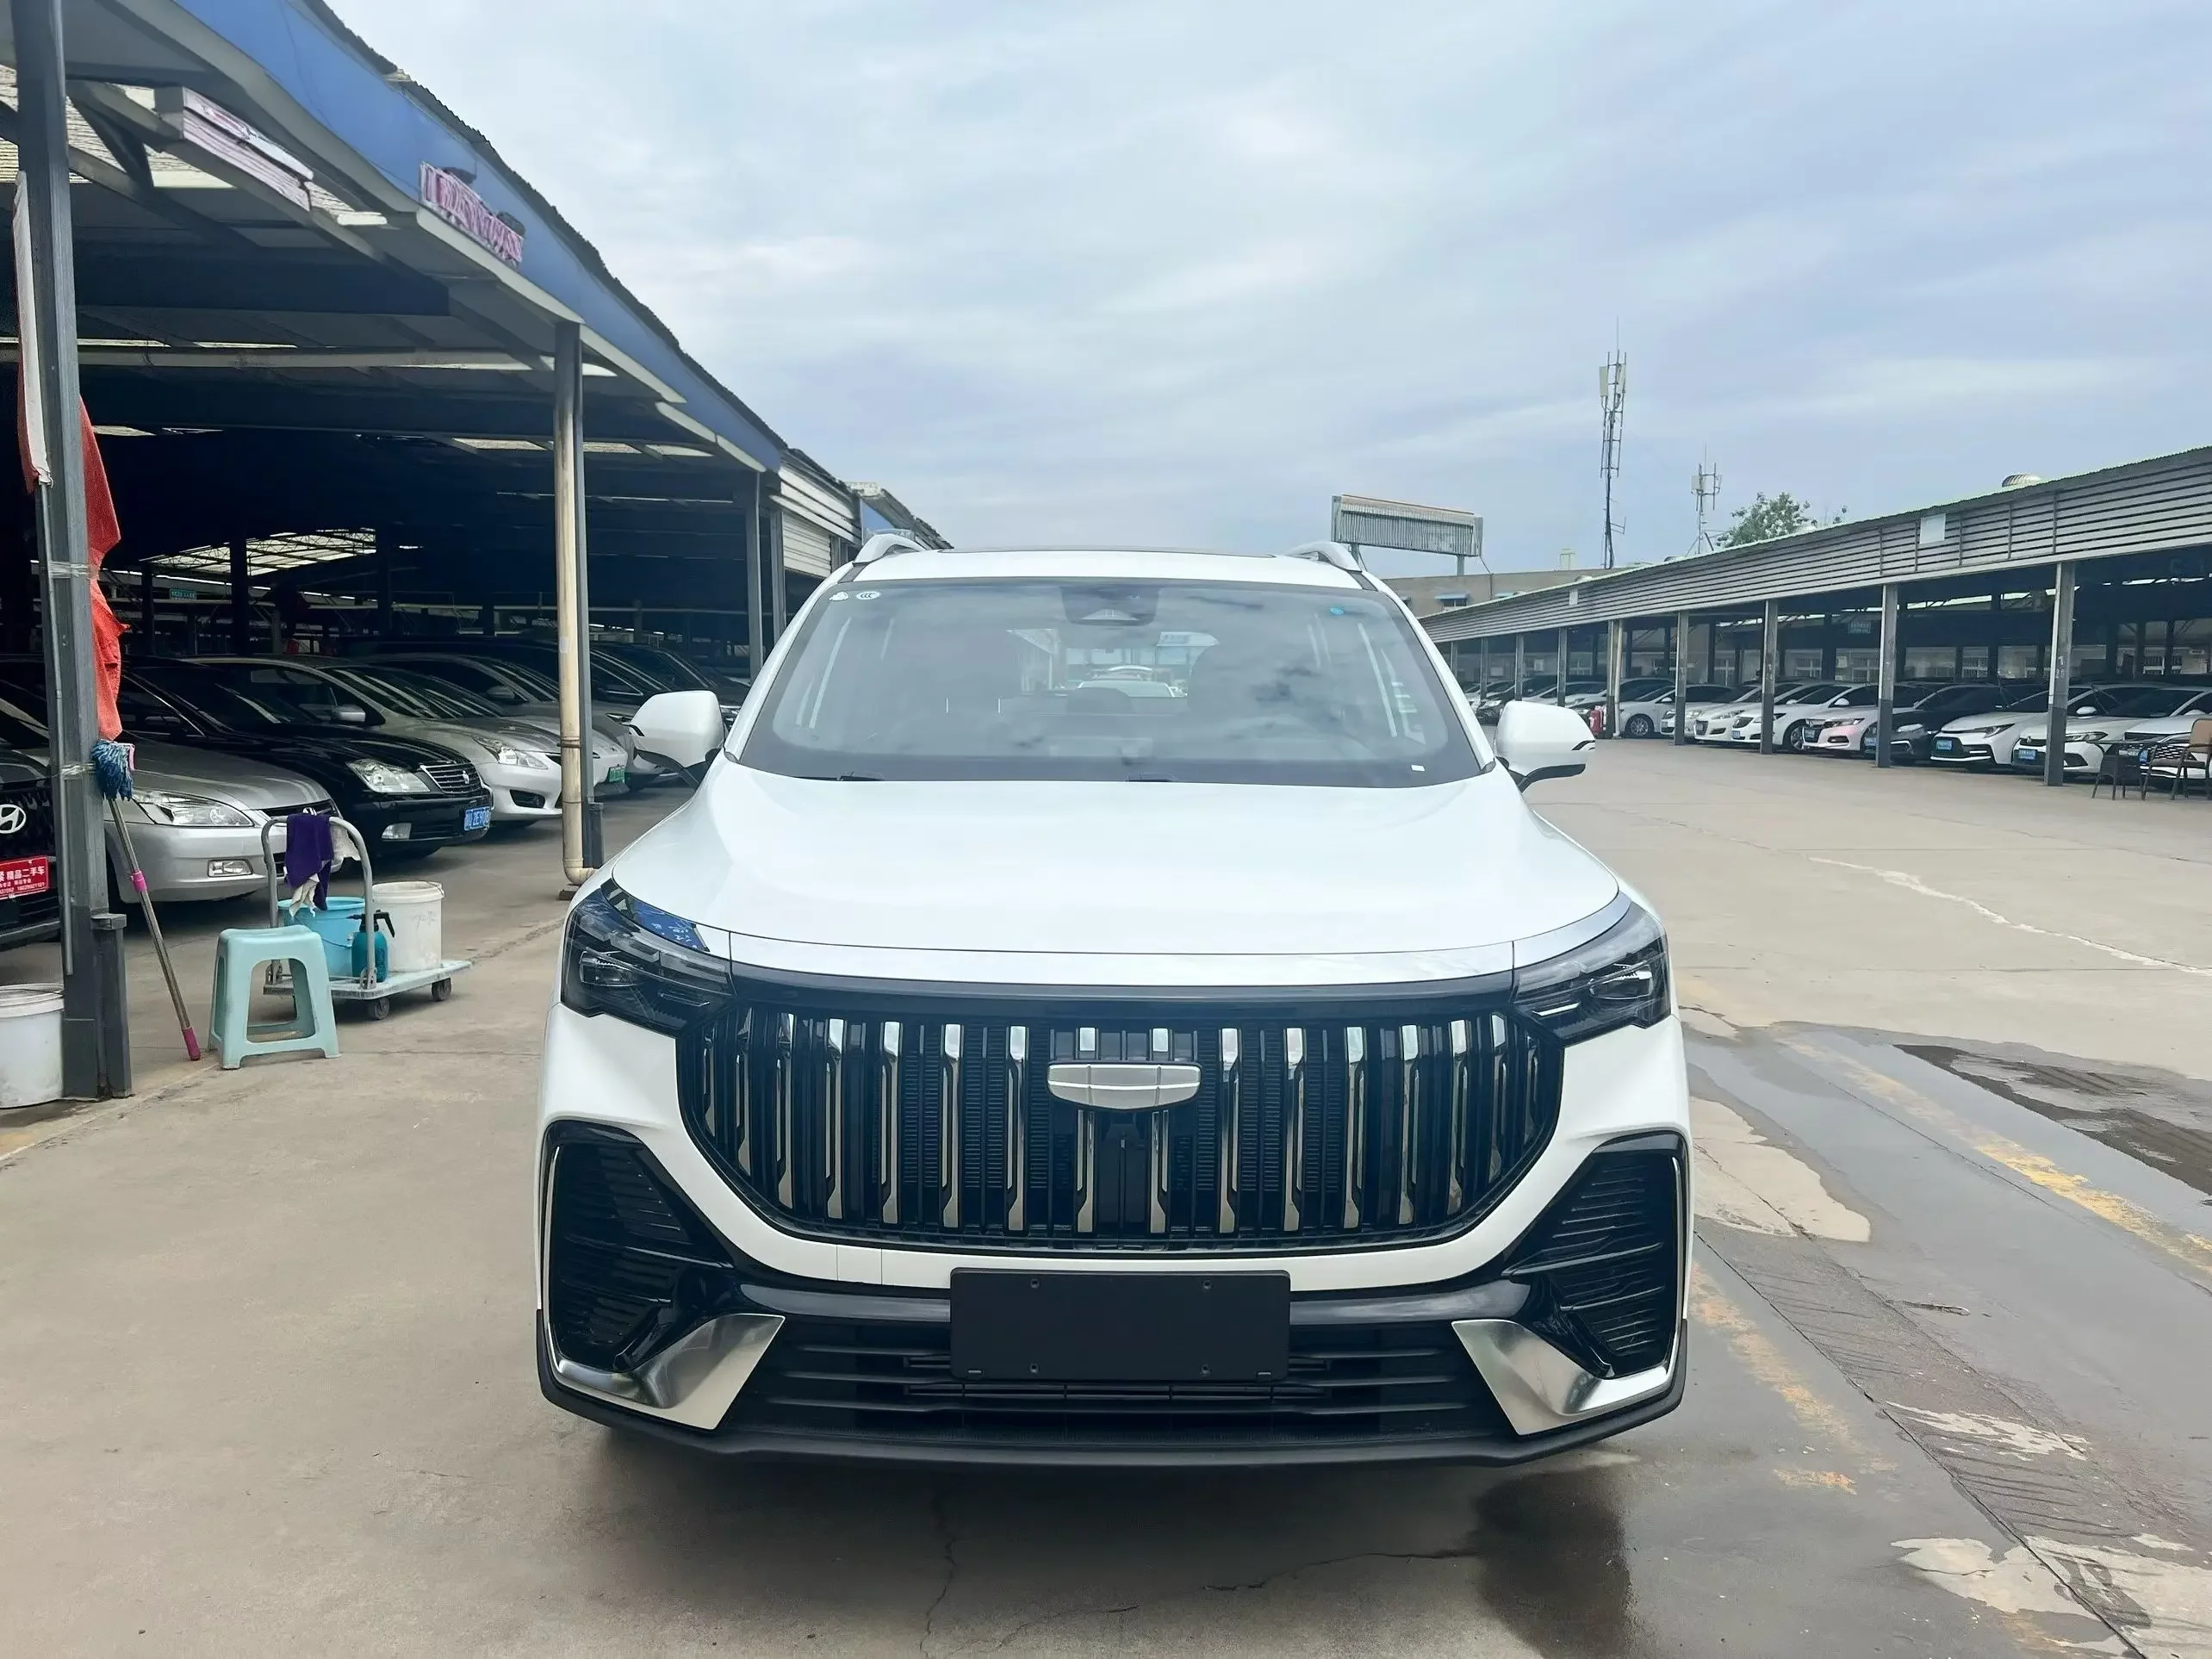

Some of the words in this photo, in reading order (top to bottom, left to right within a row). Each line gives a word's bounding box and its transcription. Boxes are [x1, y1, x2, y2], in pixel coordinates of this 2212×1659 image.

[7, 866, 45, 880] 精品二手车
